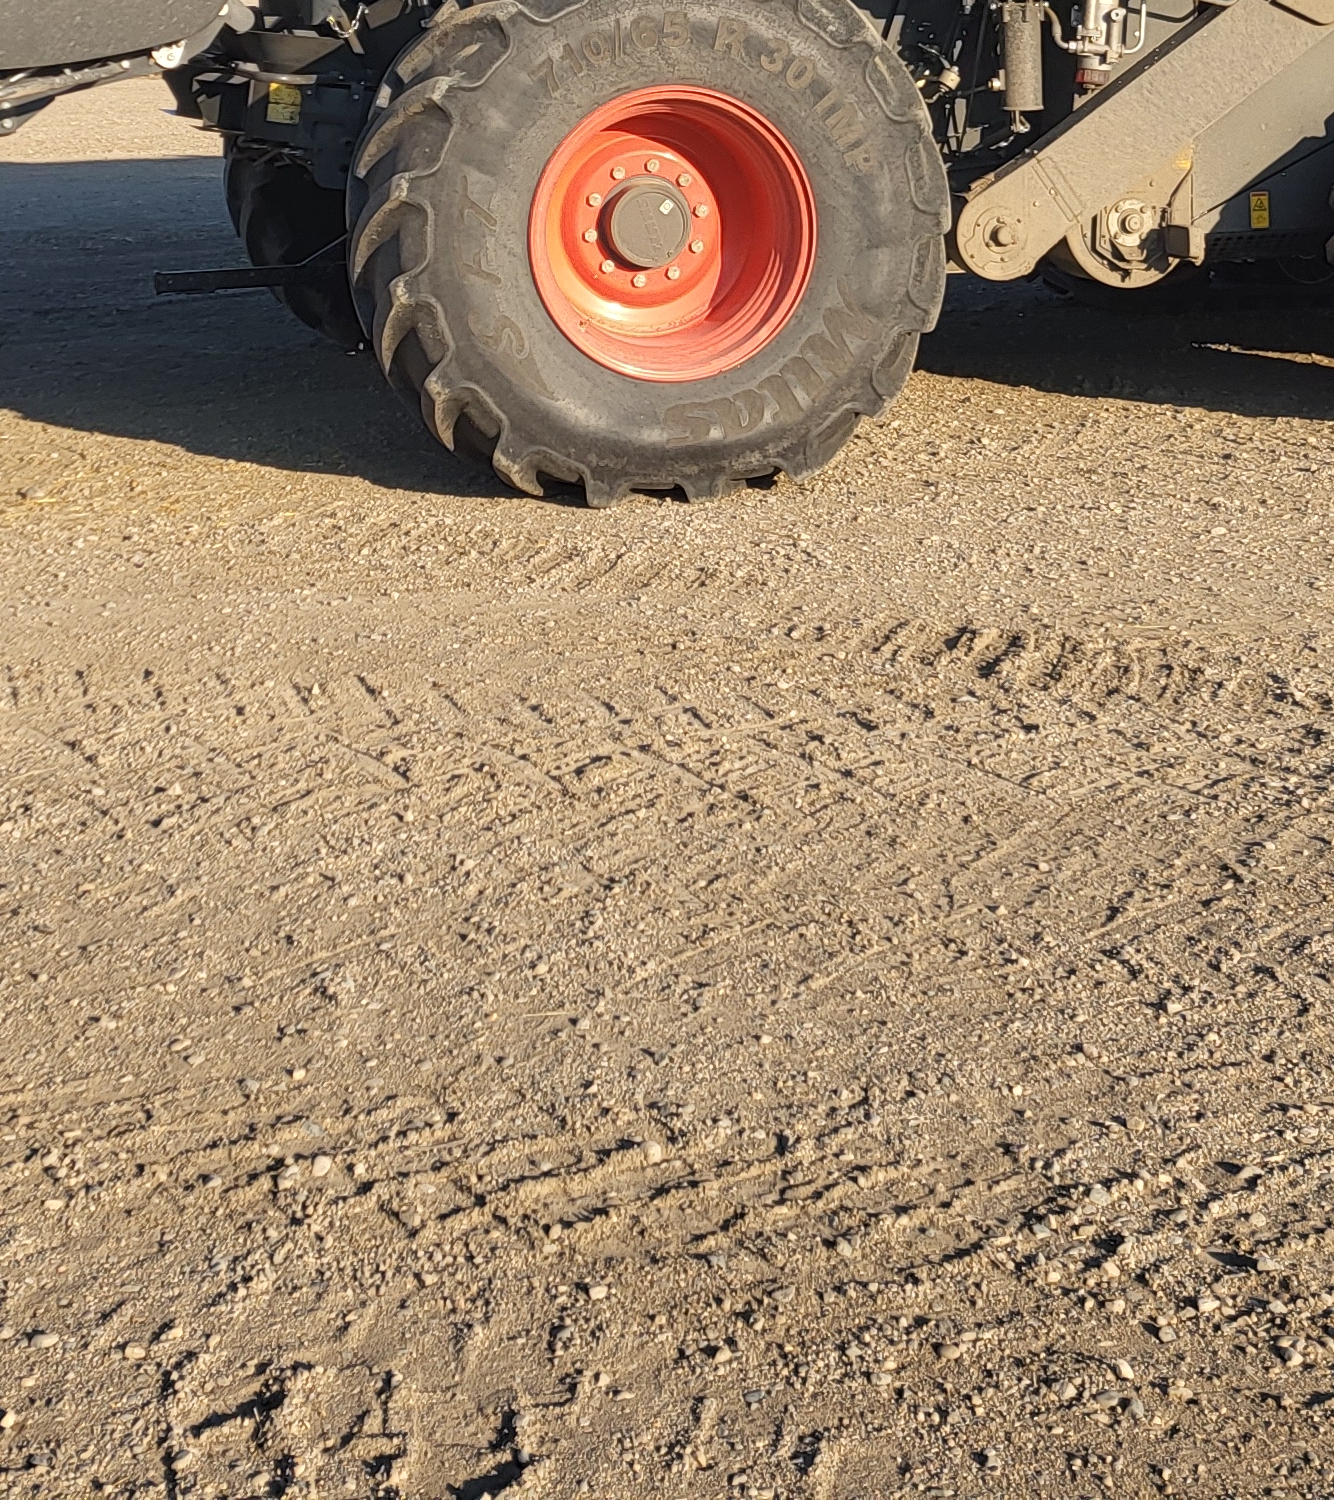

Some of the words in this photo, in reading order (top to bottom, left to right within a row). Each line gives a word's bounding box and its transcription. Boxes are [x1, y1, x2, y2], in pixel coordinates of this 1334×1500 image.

[527, 11, 689, 96] 710/65
[713, 15, 748, 60] R
[760, 38, 815, 90] 30
[808, 88, 872, 175] IMP
[665, 275, 885, 447] Mitas
